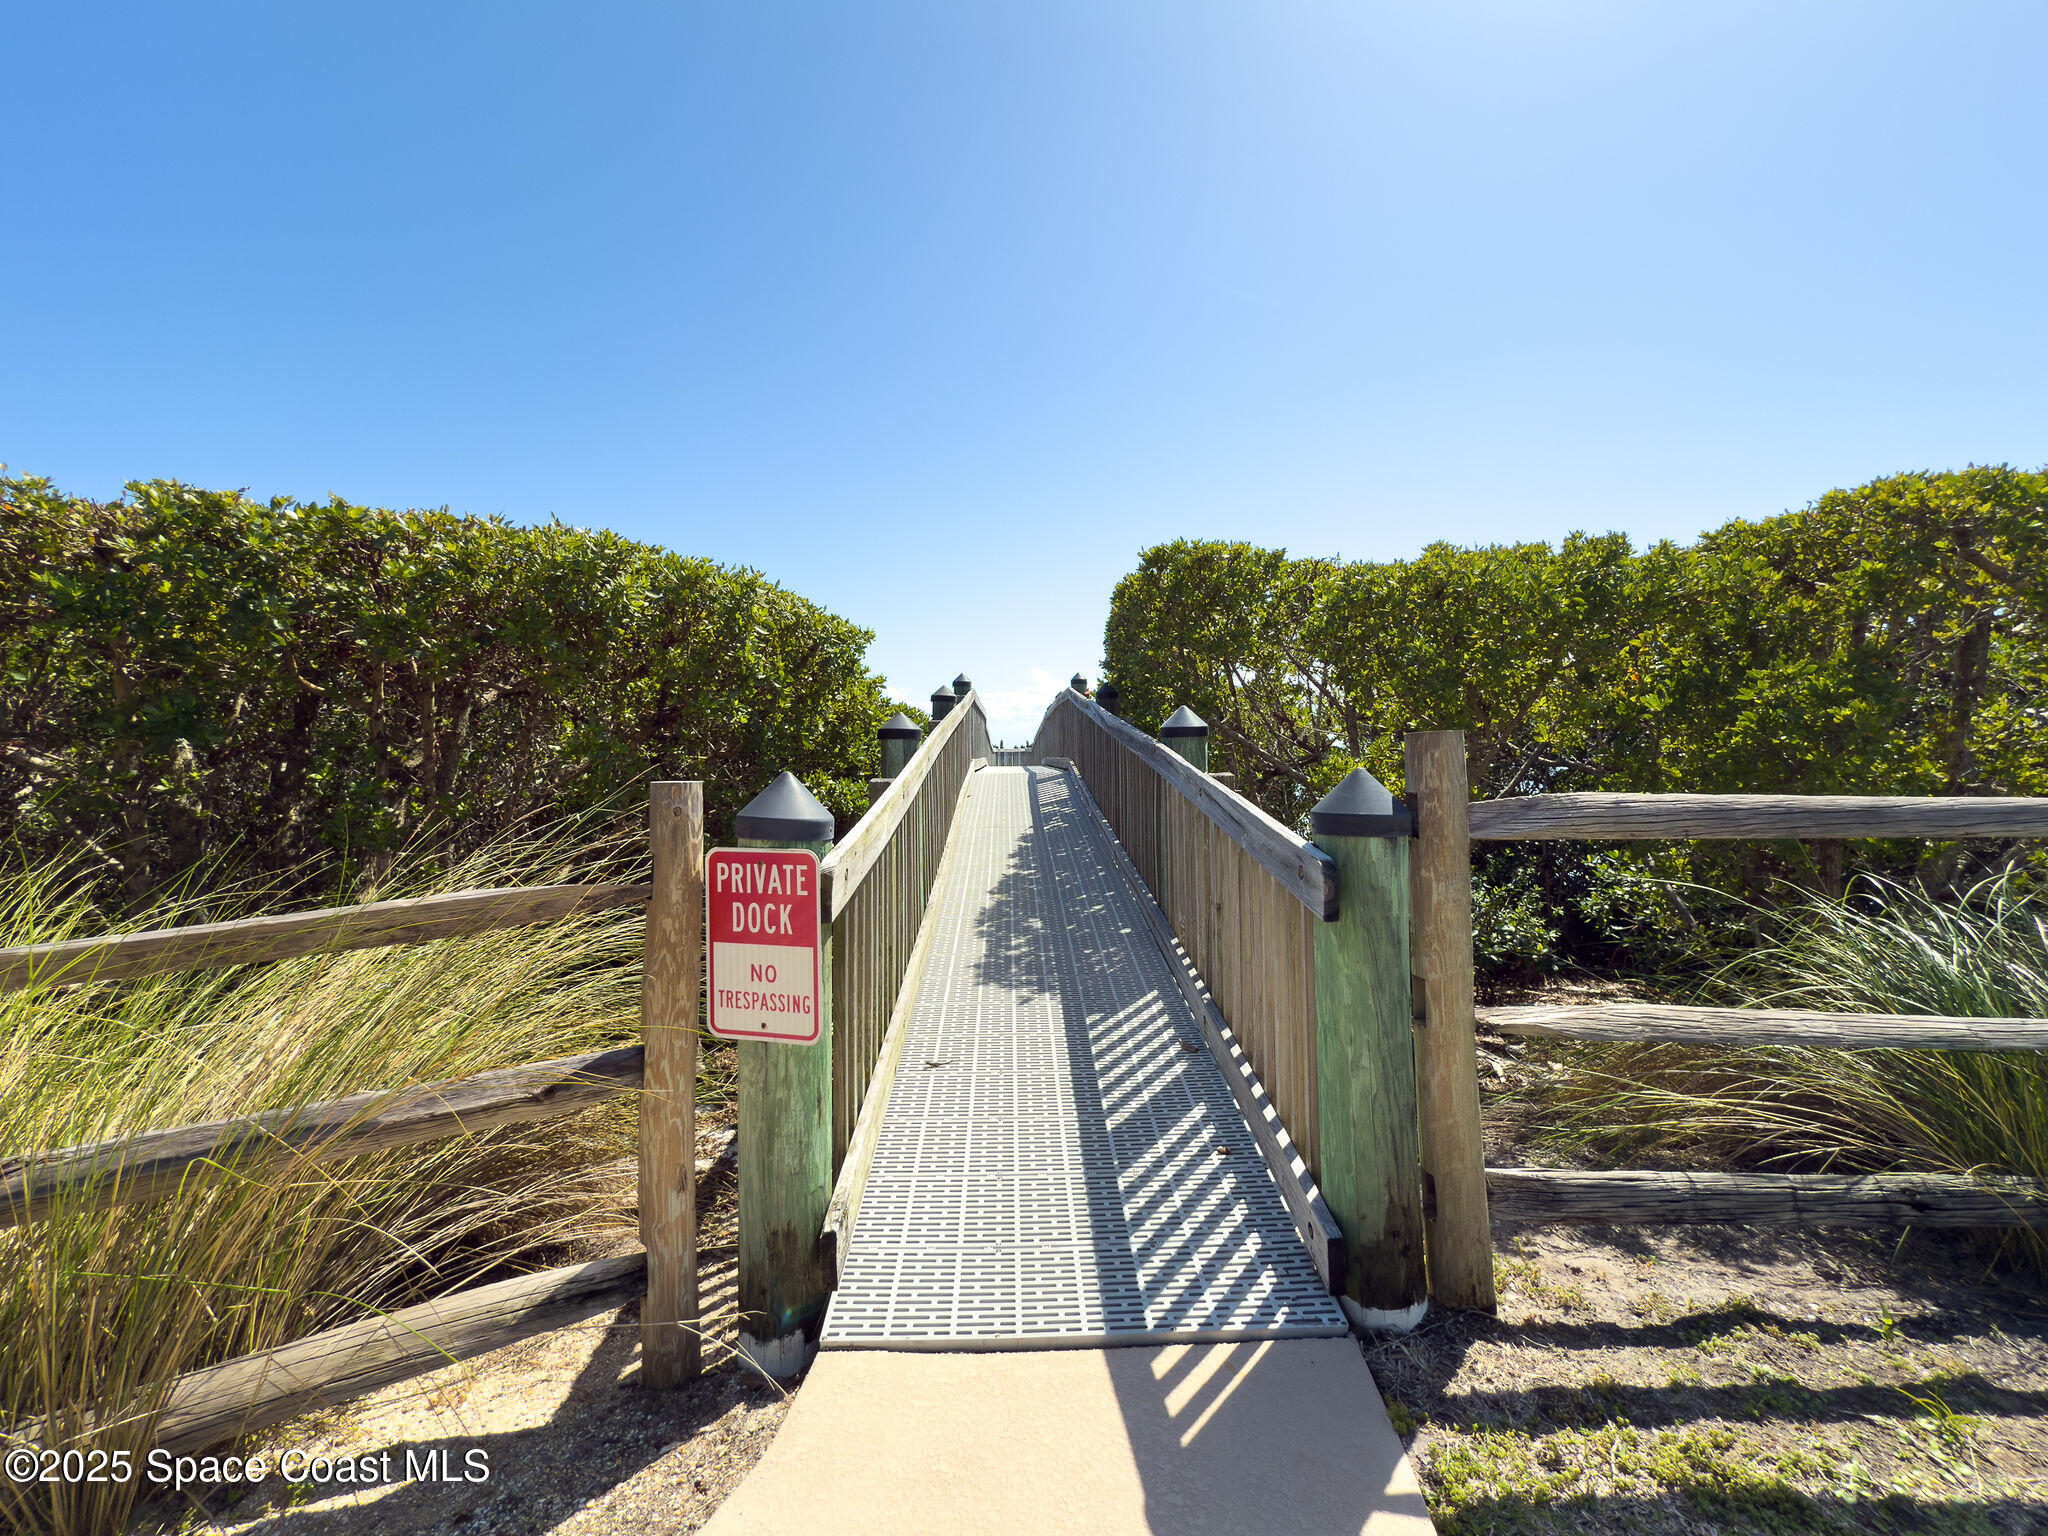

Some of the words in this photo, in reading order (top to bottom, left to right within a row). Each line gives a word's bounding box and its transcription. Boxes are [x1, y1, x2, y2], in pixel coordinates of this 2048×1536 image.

[716, 862, 809, 896] PRIVATE
[732, 902, 793, 935] DOCK
[750, 963, 778, 983] NO
[718, 989, 811, 1015] TRESPASSING
